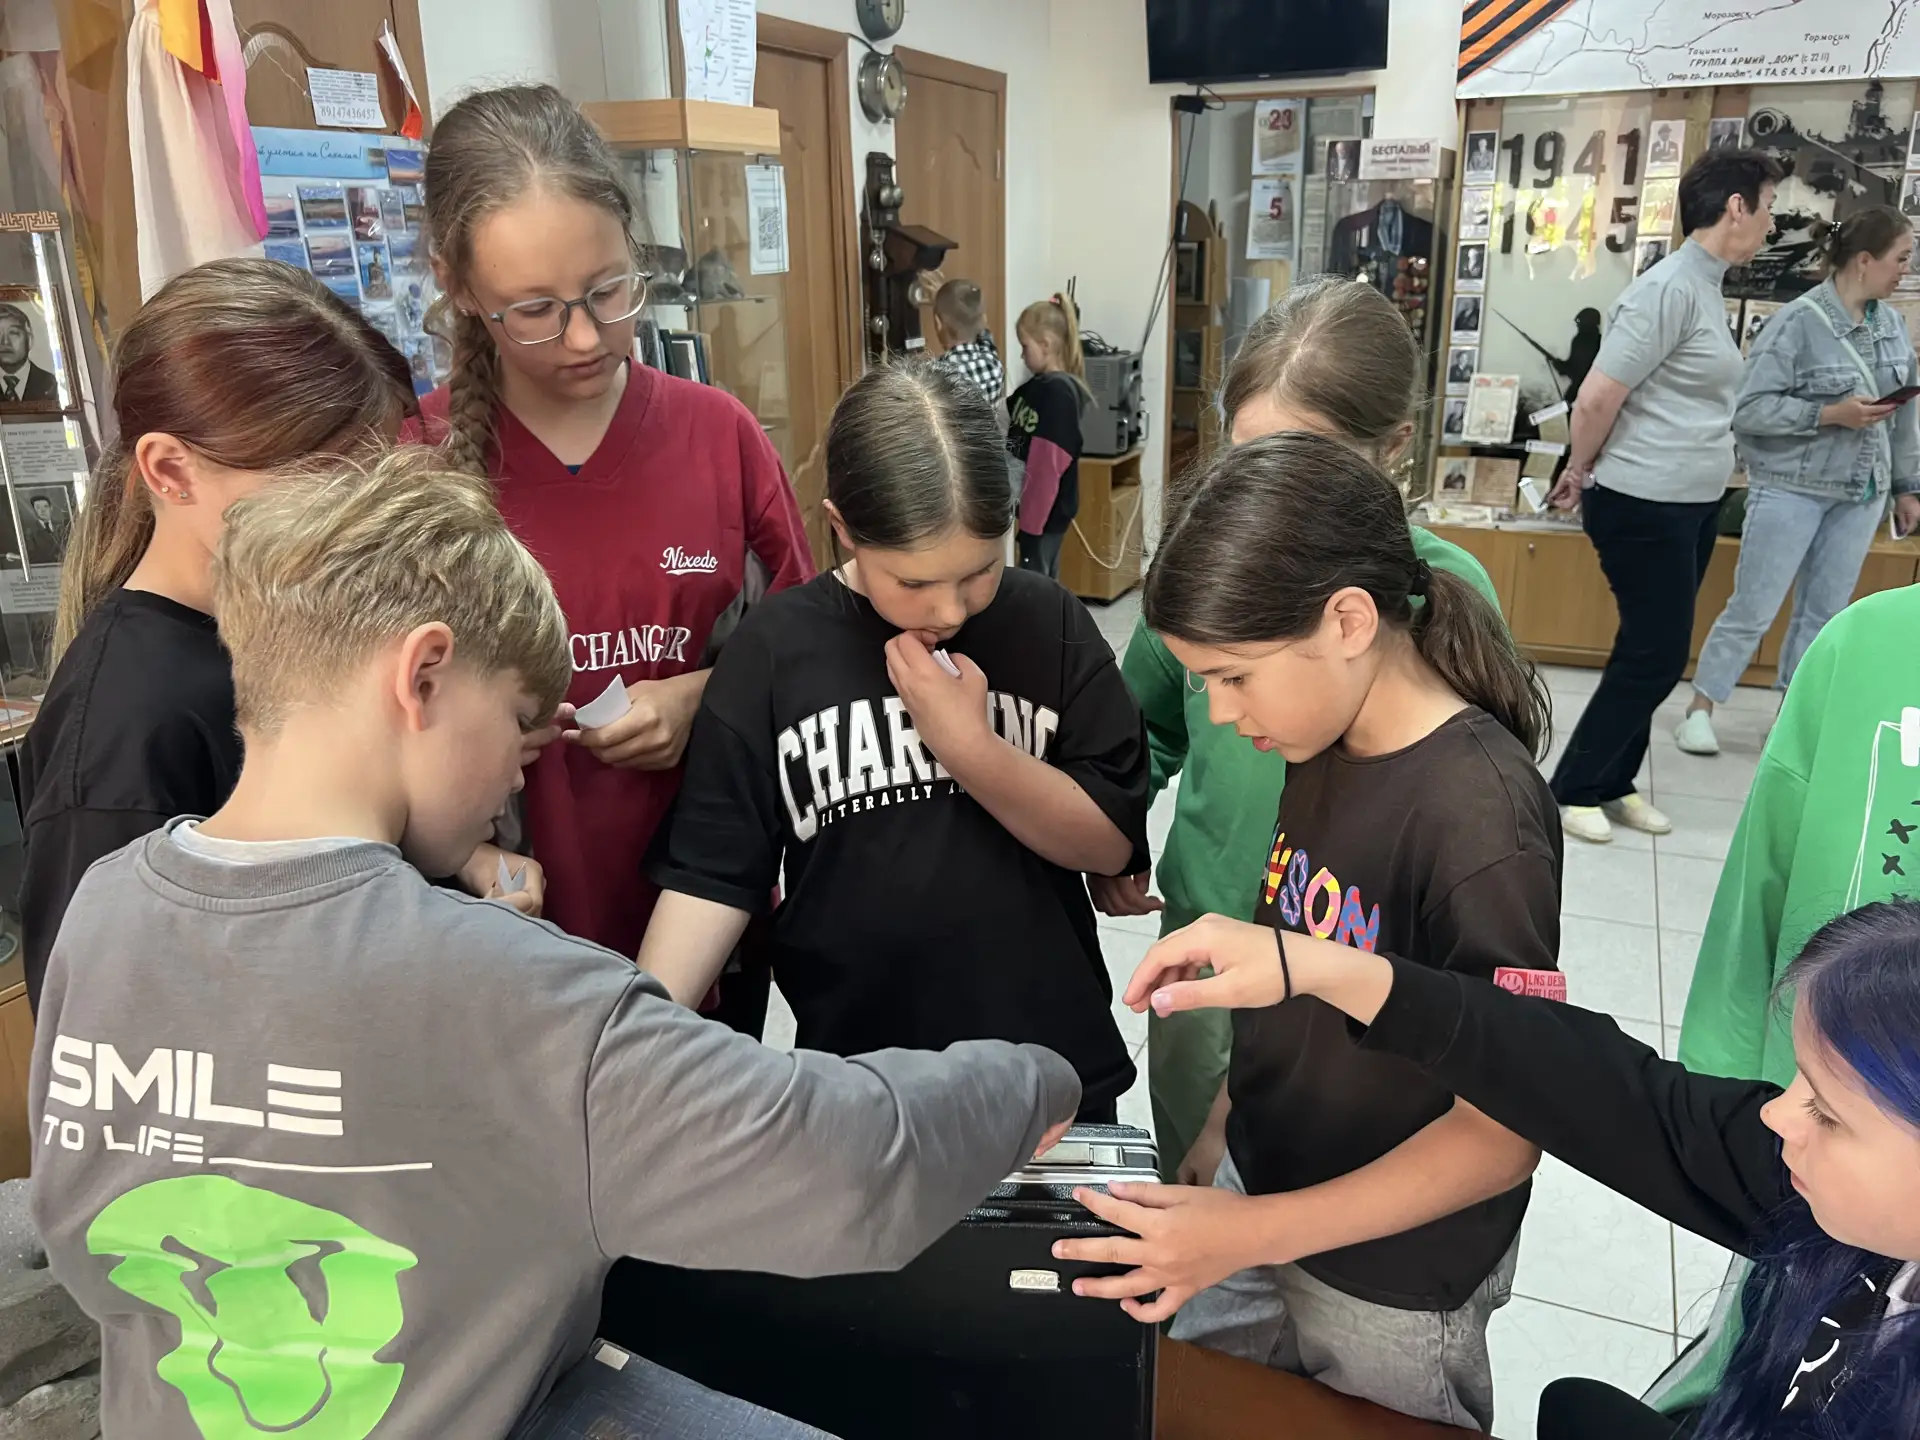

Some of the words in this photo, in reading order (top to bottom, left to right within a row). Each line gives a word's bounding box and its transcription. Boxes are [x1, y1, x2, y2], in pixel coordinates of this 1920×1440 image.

[1689, 58, 1727, 68] ГРУППА
[1730, 55, 1765, 66] АРМИЙ
[1268, 109, 1293, 131] 23
[1501, 128, 1641, 189] 1941
[1269, 197, 1283, 220] 5
[659, 545, 718, 571] Nixedo
[569, 624, 692, 673] CHANGR
[777, 689, 1060, 842] CHARNG
[47, 1034, 344, 1136] SMILE
[42, 1114, 85, 1151] TO
[103, 1124, 204, 1164] LIFE
